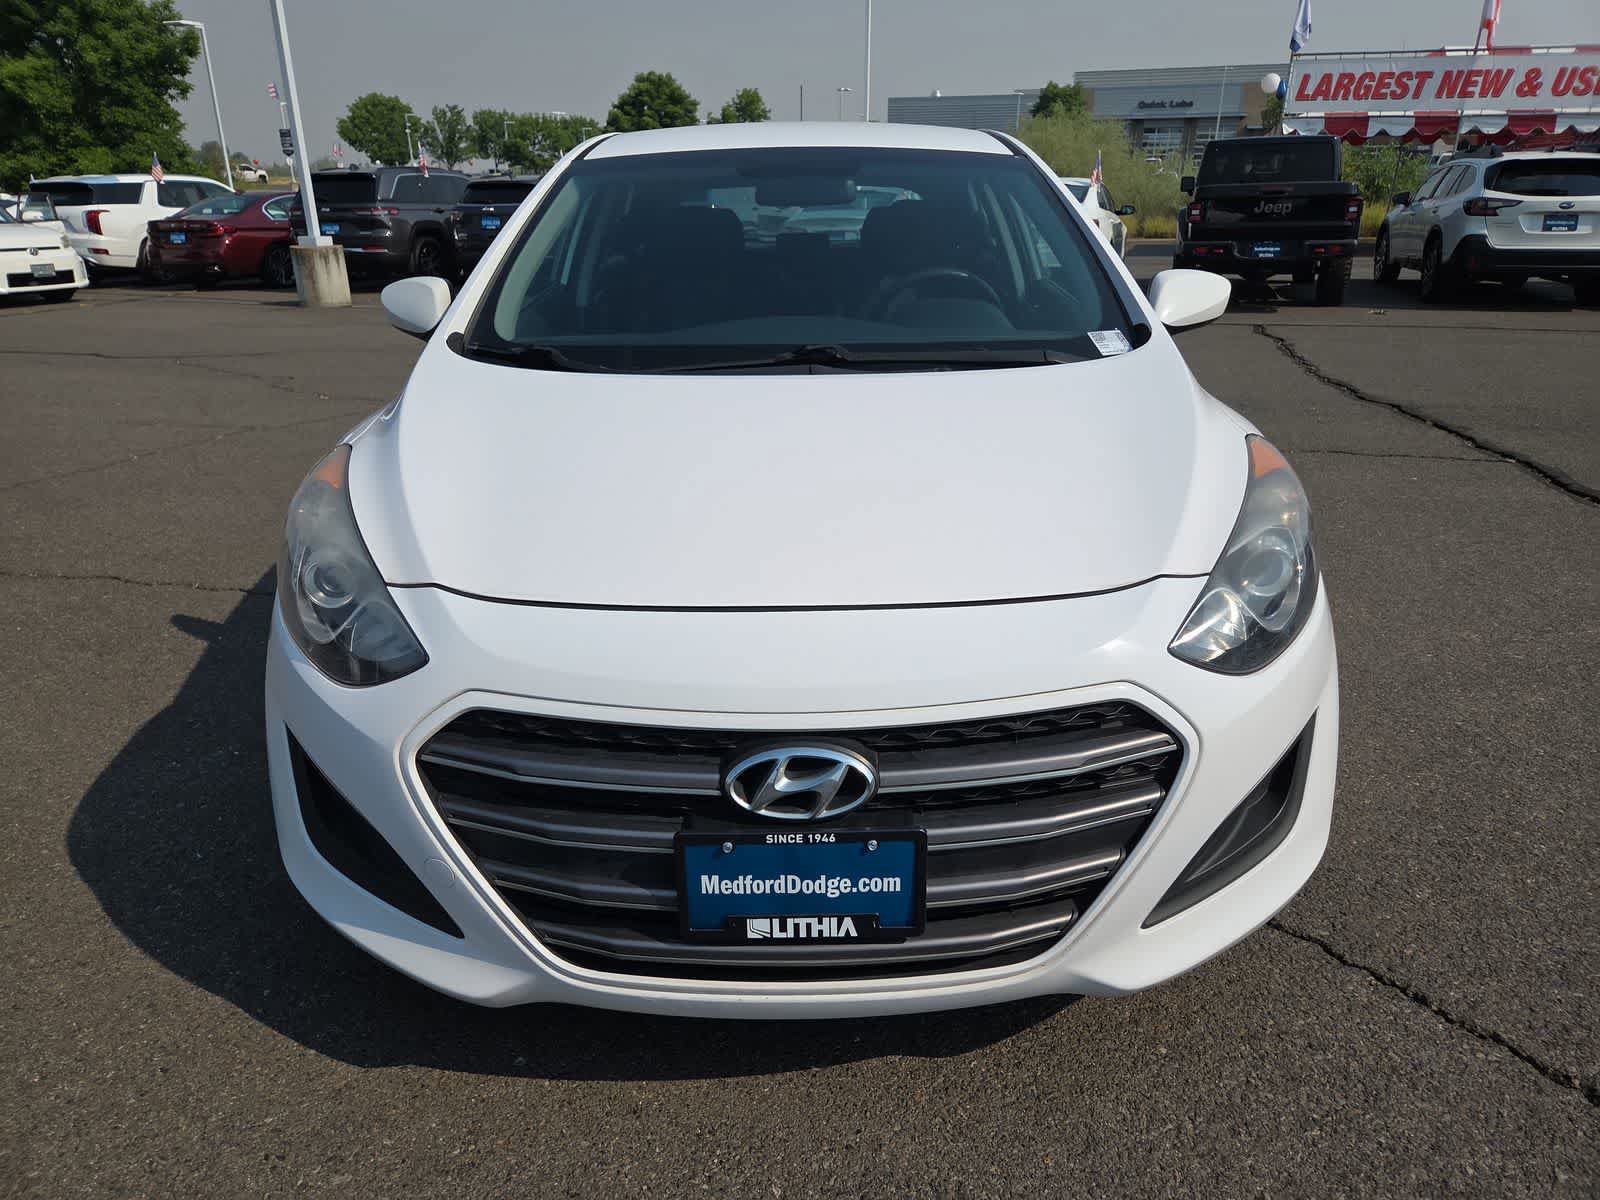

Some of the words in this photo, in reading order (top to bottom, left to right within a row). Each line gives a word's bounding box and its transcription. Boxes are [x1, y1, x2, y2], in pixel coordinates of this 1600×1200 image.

[1295, 70, 1434, 102] LARGEST
[1434, 67, 1515, 99] NEW
[1515, 67, 1544, 98] &
[1254, 200, 1292, 216] Jeep
[765, 834, 804, 844] SINCE
[807, 833, 836, 844] 1946
[700, 874, 901, 898] MedfordDodge.com
[771, 917, 858, 938] LITHIA
